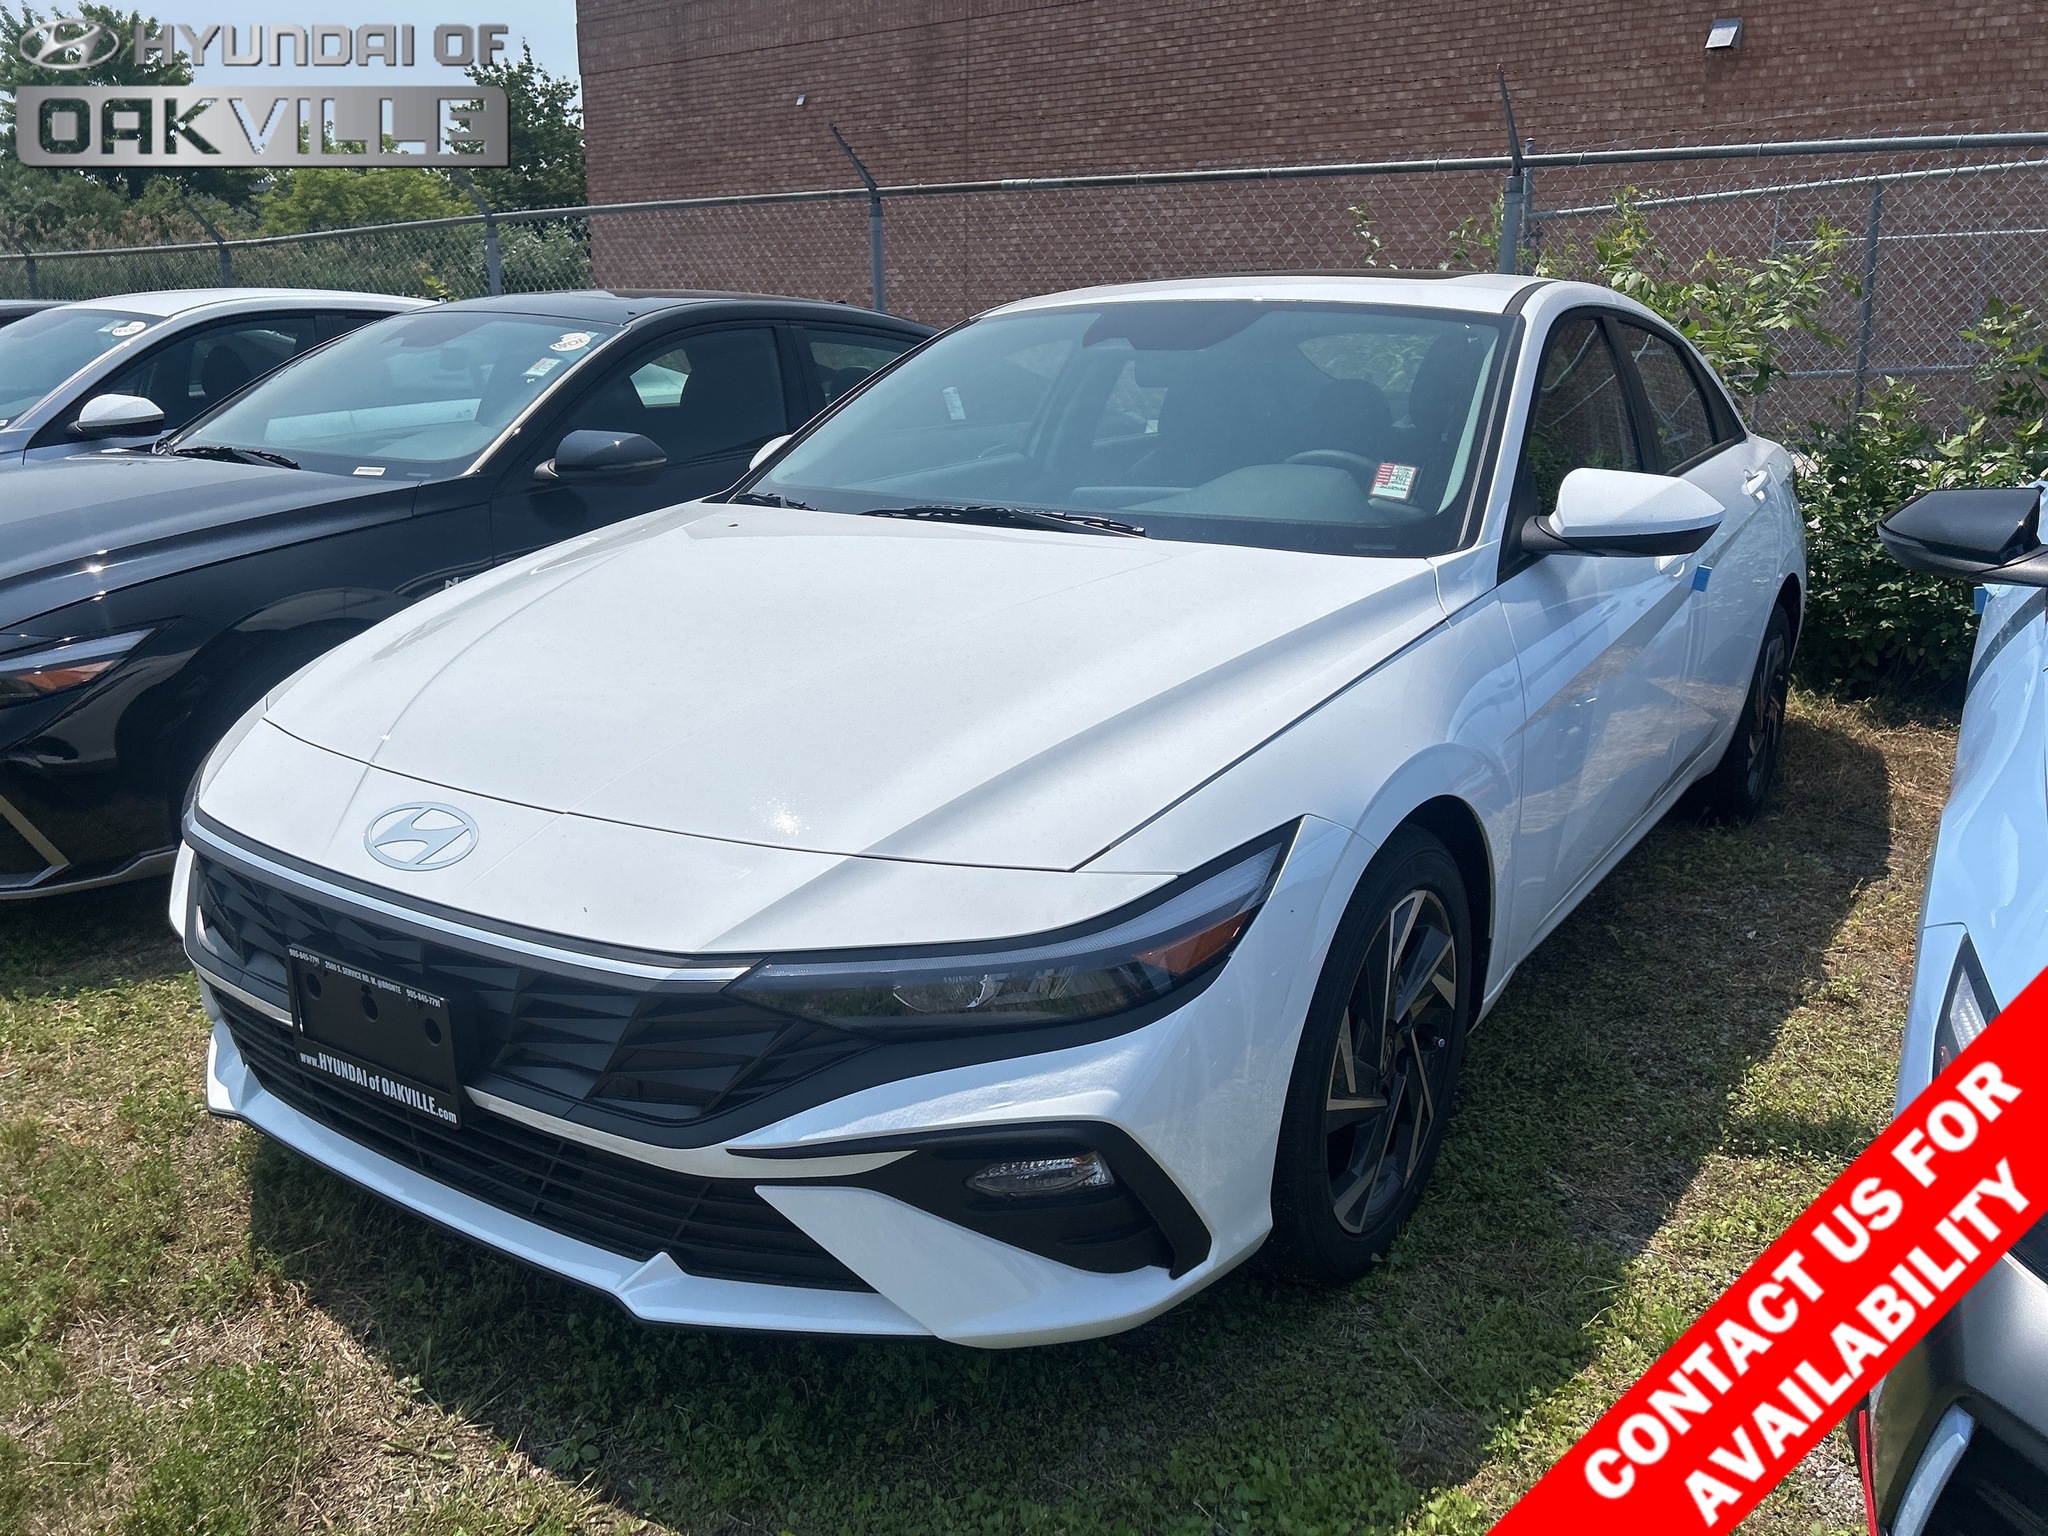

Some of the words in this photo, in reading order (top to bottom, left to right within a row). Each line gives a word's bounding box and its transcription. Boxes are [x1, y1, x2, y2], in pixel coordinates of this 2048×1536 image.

[342, 966, 362, 981] SERVICE
[406, 988, 441, 1008] 905-845-7791
[299, 1052, 368, 1088] www.HYUNDAI
[369, 1075, 380, 1092] of
[381, 1077, 457, 1124] OAKVILLE.com
